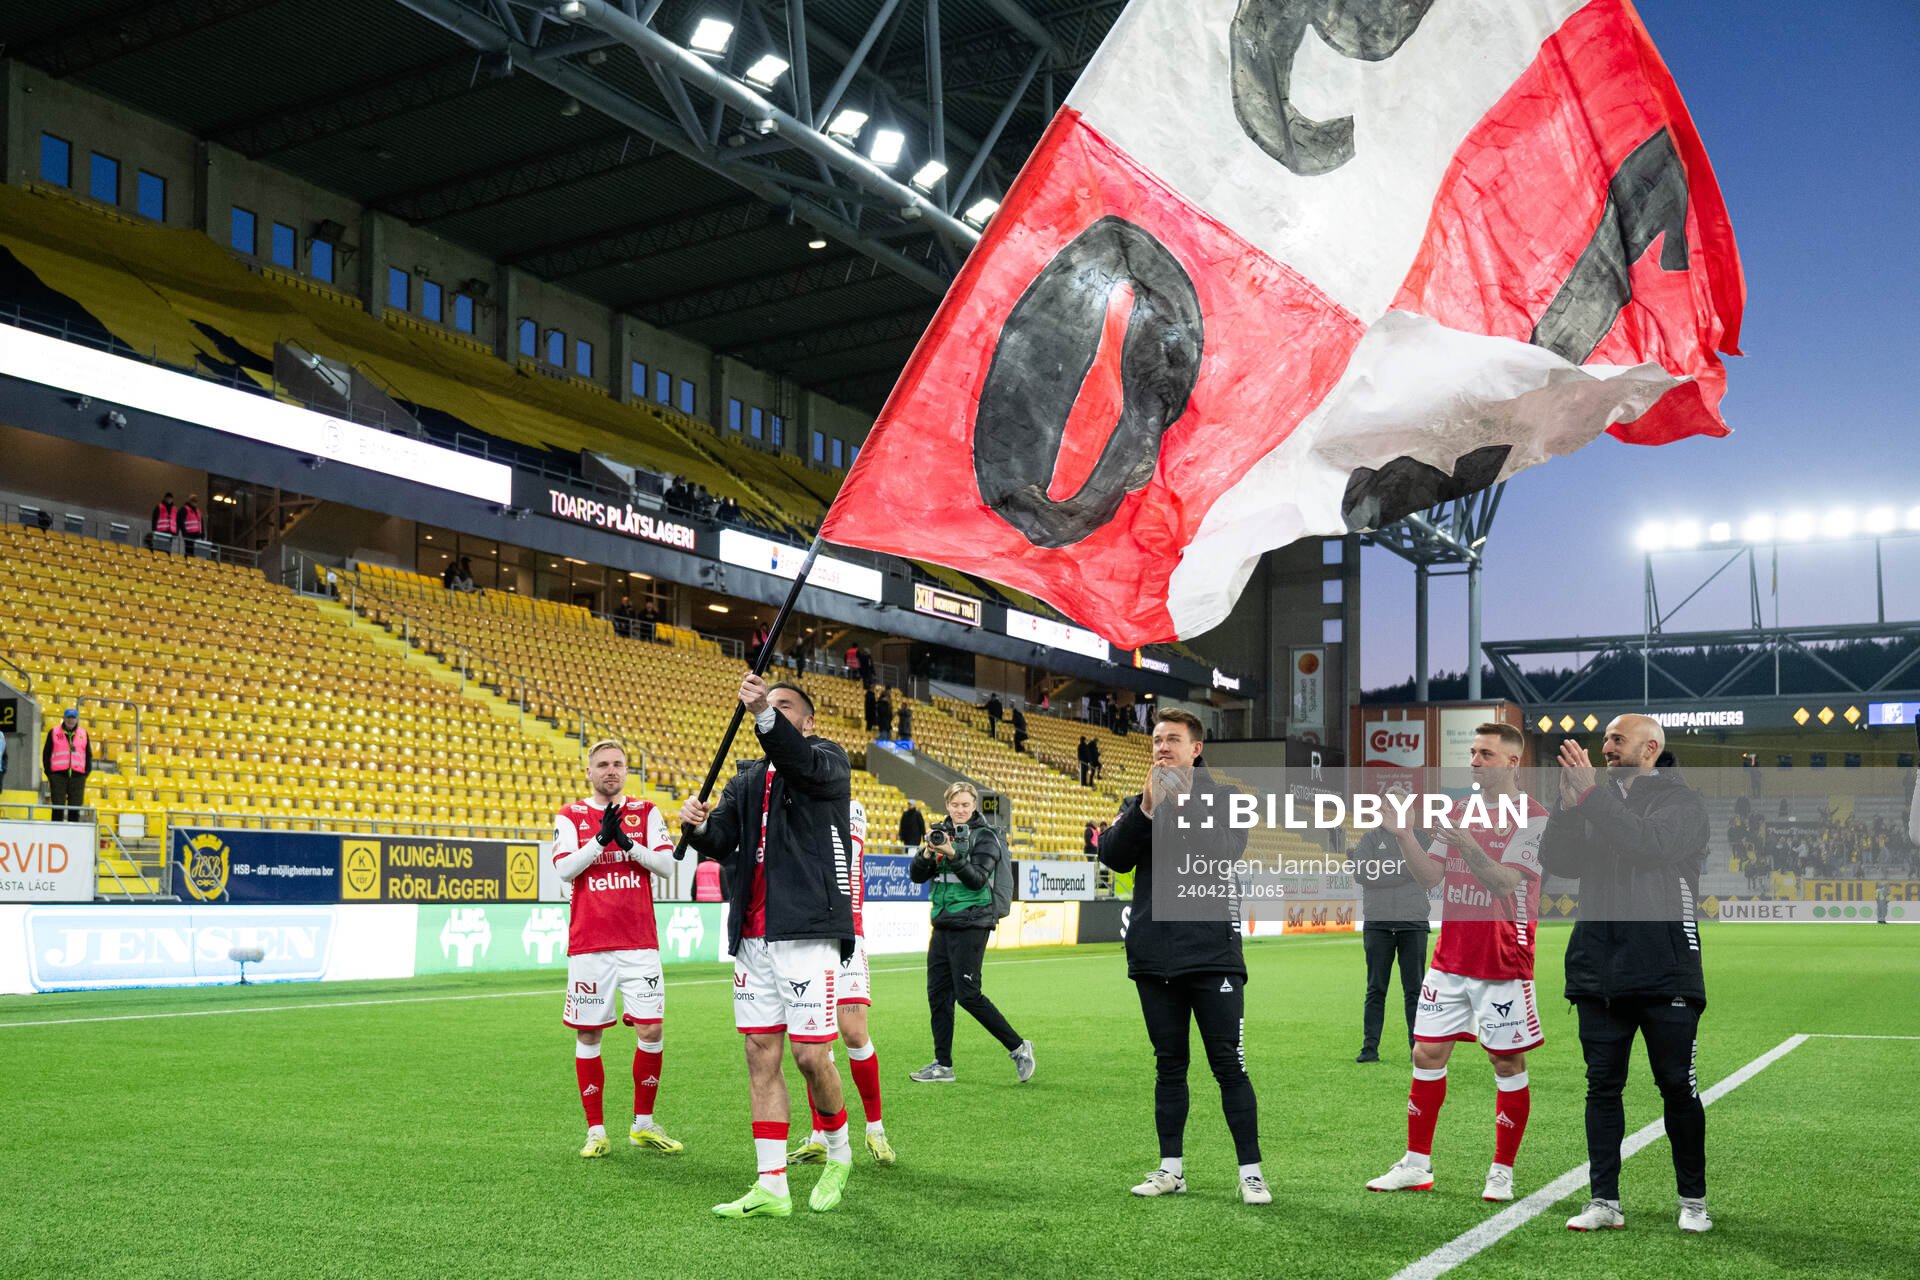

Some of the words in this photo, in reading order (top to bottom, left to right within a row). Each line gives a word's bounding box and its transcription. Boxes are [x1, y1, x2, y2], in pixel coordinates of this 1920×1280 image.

[549, 489, 606, 526] TOARPS
[606, 503, 695, 550] PLÅTSLAGERI
[0, 706, 14, 724] 2
[1644, 711, 1744, 727] VUDPARTNERS
[1370, 730, 1420, 753] City
[388, 843, 473, 869] KUNGÄLVS
[233, 864, 250, 875] HSB
[257, 864, 270, 876] där
[271, 865, 321, 878] möjligheterna
[322, 866, 334, 876] bor
[587, 870, 641, 892] telink
[863, 860, 906, 883] Sjömarkens
[28, 879, 56, 891] LÄGE
[388, 874, 499, 899] RÖRLÄGGERI
[867, 879, 882, 896] och
[883, 879, 908, 897] Smide
[908, 883, 923, 897] AB
[1722, 905, 1797, 919] UNIBET
[44, 926, 321, 968] JENSEN
[570, 995, 605, 1005] Nybloms
